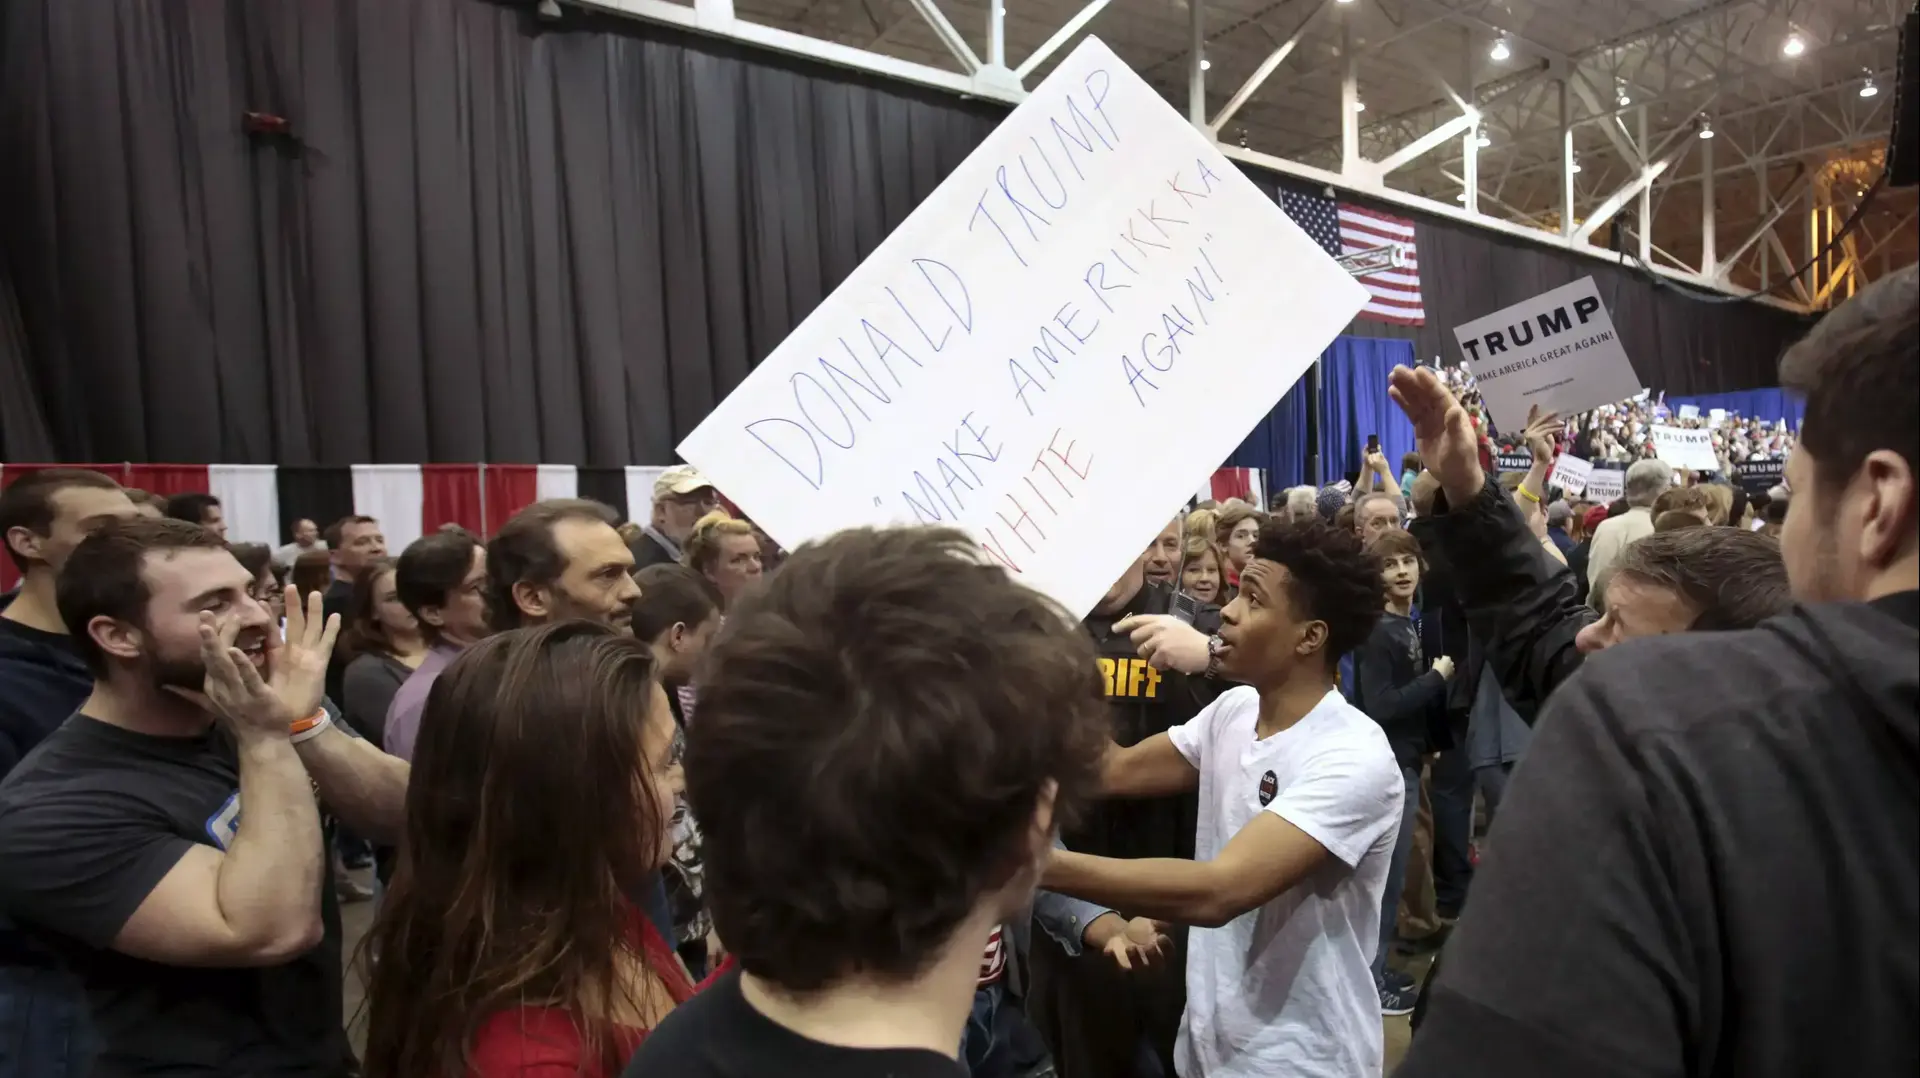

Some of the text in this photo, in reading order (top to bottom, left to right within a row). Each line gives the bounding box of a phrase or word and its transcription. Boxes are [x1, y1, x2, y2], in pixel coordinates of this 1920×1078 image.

[745, 69, 1119, 490] DONALD TRUMP
[1006, 157, 1222, 416] AMERIKKKA
[1462, 295, 1600, 362] TRUMP
[1476, 329, 1615, 383] MAKE AMERICA GREAT AGAIN!
[1654, 431, 1709, 444] TRUMP
[1499, 457, 1532, 467] TRUMP
[1555, 472, 1585, 487] TRUMP
[1589, 487, 1621, 497] TRUMP
